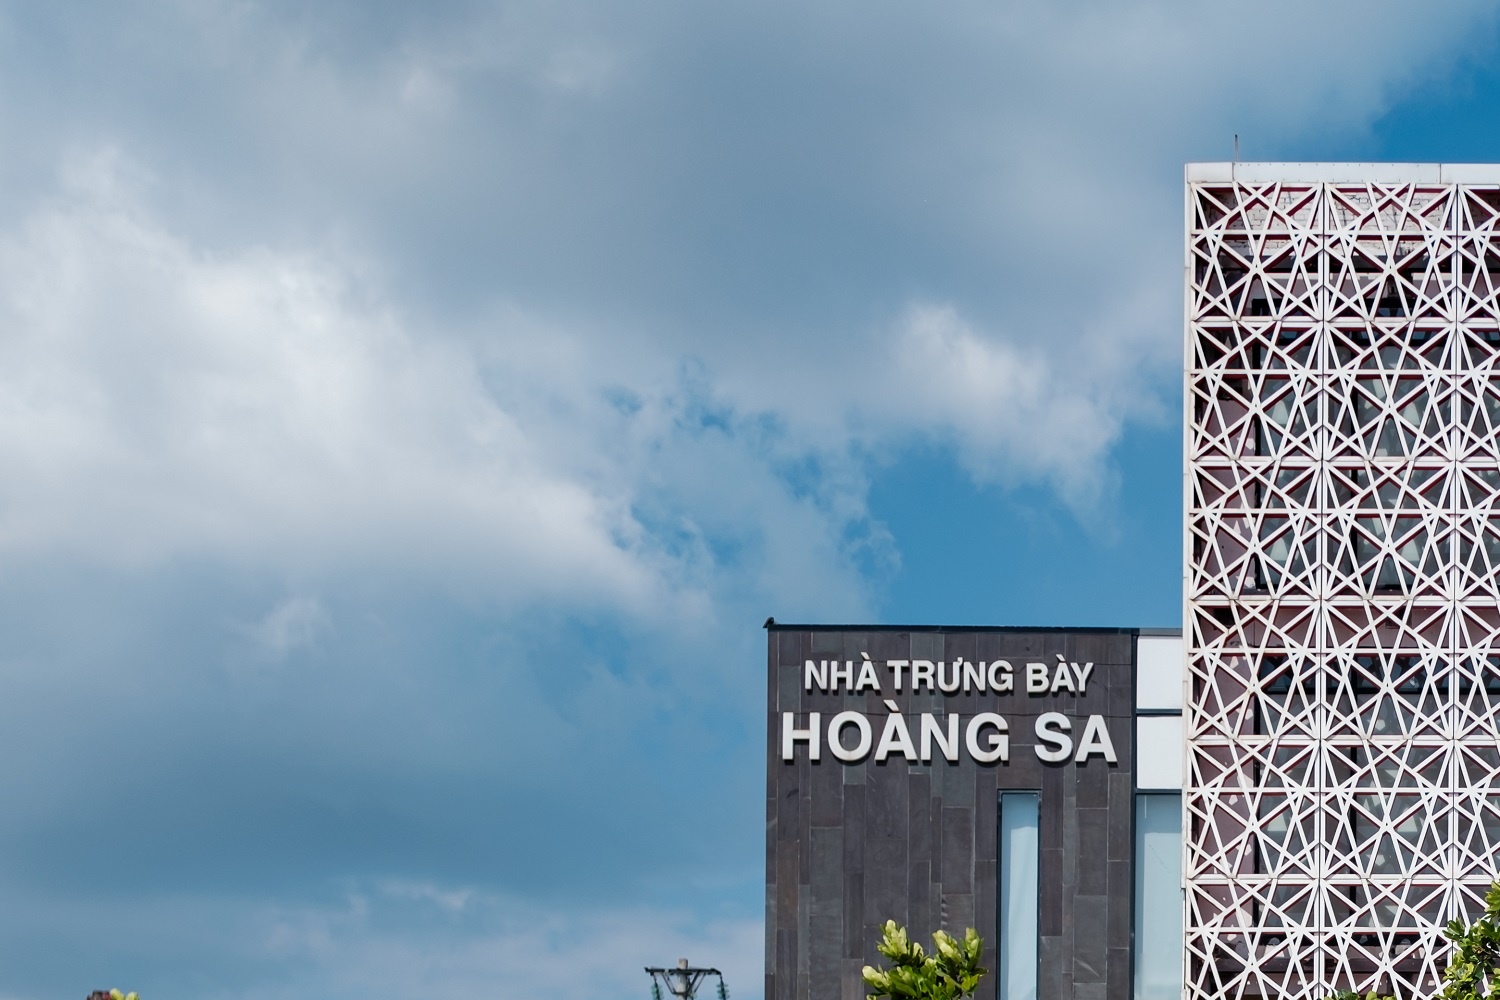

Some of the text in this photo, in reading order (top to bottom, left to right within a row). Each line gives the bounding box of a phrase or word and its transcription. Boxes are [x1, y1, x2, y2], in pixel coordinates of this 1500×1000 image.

[805, 652, 1094, 693] NHÀ TRƯNG BÀY
[782, 699, 1118, 763] HOÀNG SA
